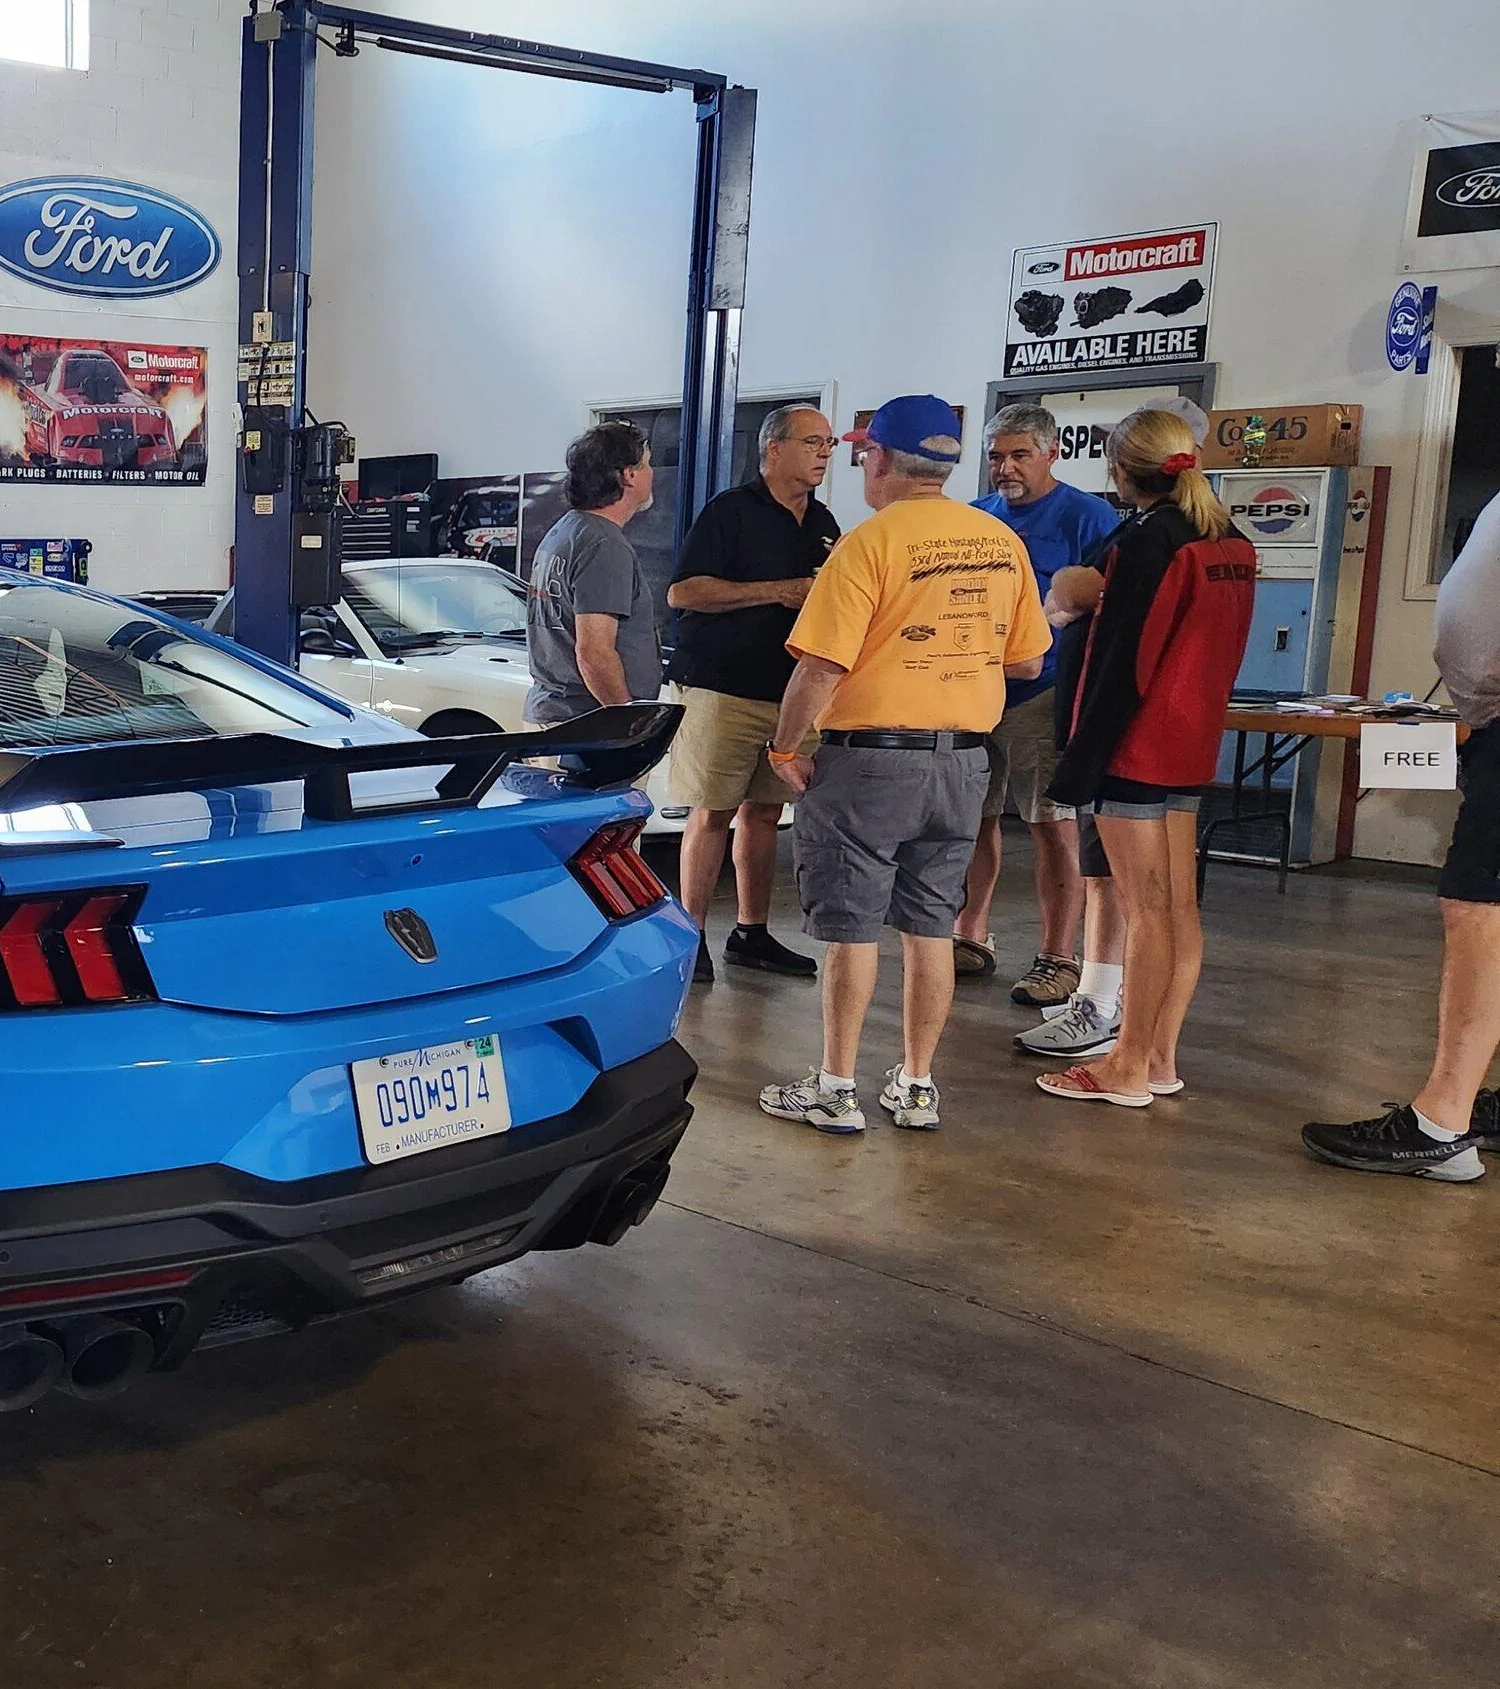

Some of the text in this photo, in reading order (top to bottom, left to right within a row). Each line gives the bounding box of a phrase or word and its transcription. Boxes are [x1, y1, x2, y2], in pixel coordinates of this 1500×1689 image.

[24, 193, 174, 279] Ford
[1069, 237, 1198, 276] Motorcraft
[1391, 312, 1418, 336] Ford
[1012, 329, 1198, 367] AVAILABLE HERE
[148, 353, 199, 370] Motorcraft
[1010, 365, 1035, 375] QUALITY
[1035, 364, 1048, 372] GAS
[1077, 360, 1099, 368] DIESEL
[1144, 352, 1198, 363] TRANSMISSIONS
[135, 373, 194, 384] motorcraft.com
[62, 406, 164, 420] Motorcraft
[1269, 416, 1308, 441] 45
[16, 468, 46, 479] PLUGS
[56, 469, 103, 479] BATTERIES
[112, 470, 146, 480] FILTERS
[154, 470, 183, 480] MOTOR
[186, 471, 200, 481] OIL
[1230, 504, 1310, 517] PEPSI
[1384, 752, 1441, 767] FREE
[393, 1060, 413, 1068] PURE
[411, 1049, 461, 1072] MICHIGAN
[376, 1062, 489, 1127] 090M974
[376, 1119, 478, 1155] FEB MANUFACTURER
[1392, 1144, 1460, 1160] MERRELL
